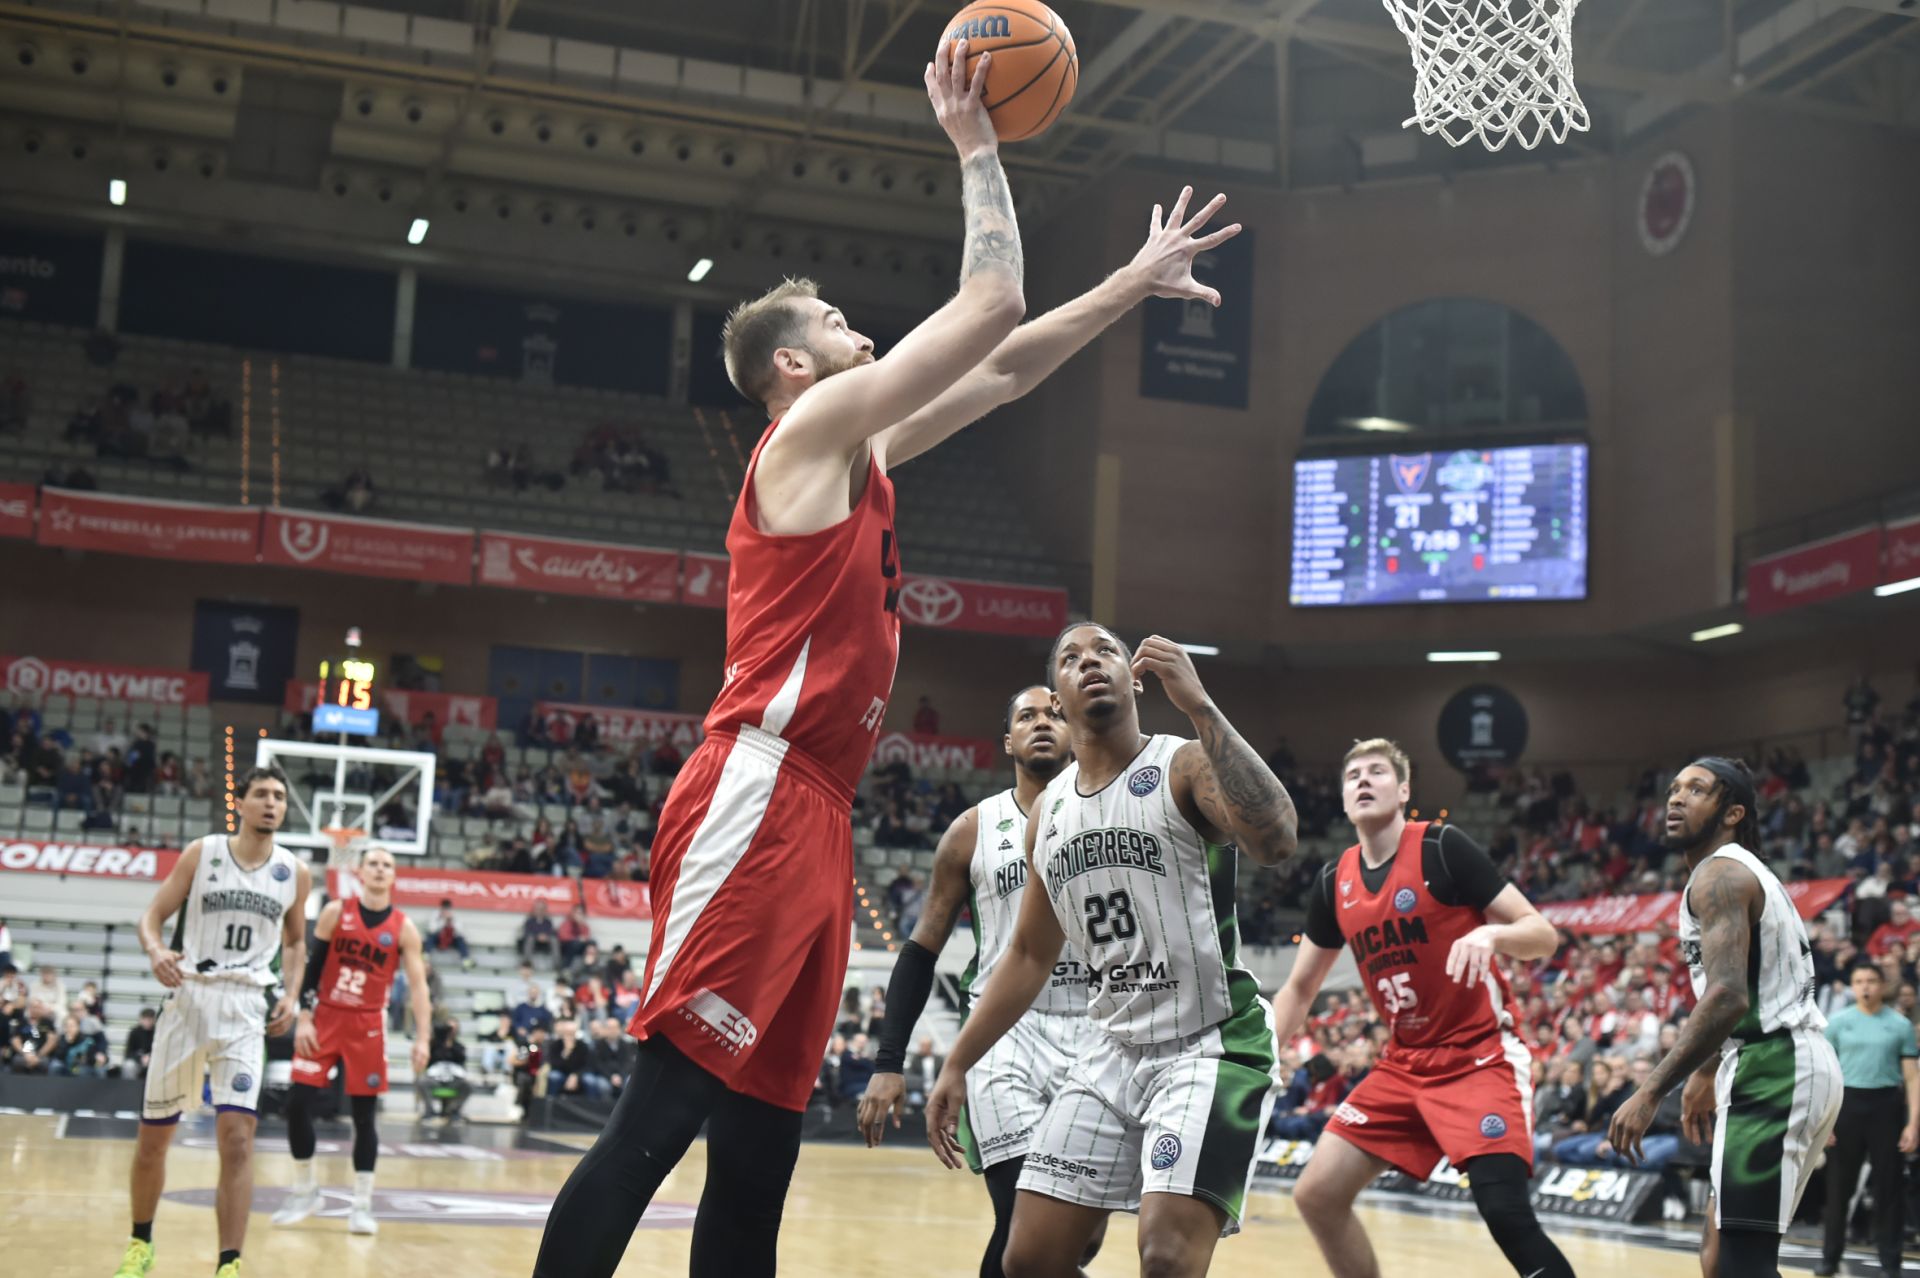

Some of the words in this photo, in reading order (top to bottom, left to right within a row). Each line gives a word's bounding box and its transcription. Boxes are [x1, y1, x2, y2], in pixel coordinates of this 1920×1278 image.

[53, 668, 185, 702] POLYMEC
[338, 679, 372, 710] 15
[0, 842, 157, 877] ONERA
[1046, 826, 1166, 904] NANTERRE92
[1084, 887, 1136, 946] 23
[224, 923, 253, 952] 10
[334, 937, 388, 968] UCAM
[1350, 916, 1430, 965] UCAM
[335, 966, 367, 995] 22
[1109, 961, 1167, 982] GTM
[1377, 972, 1418, 1014] 35
